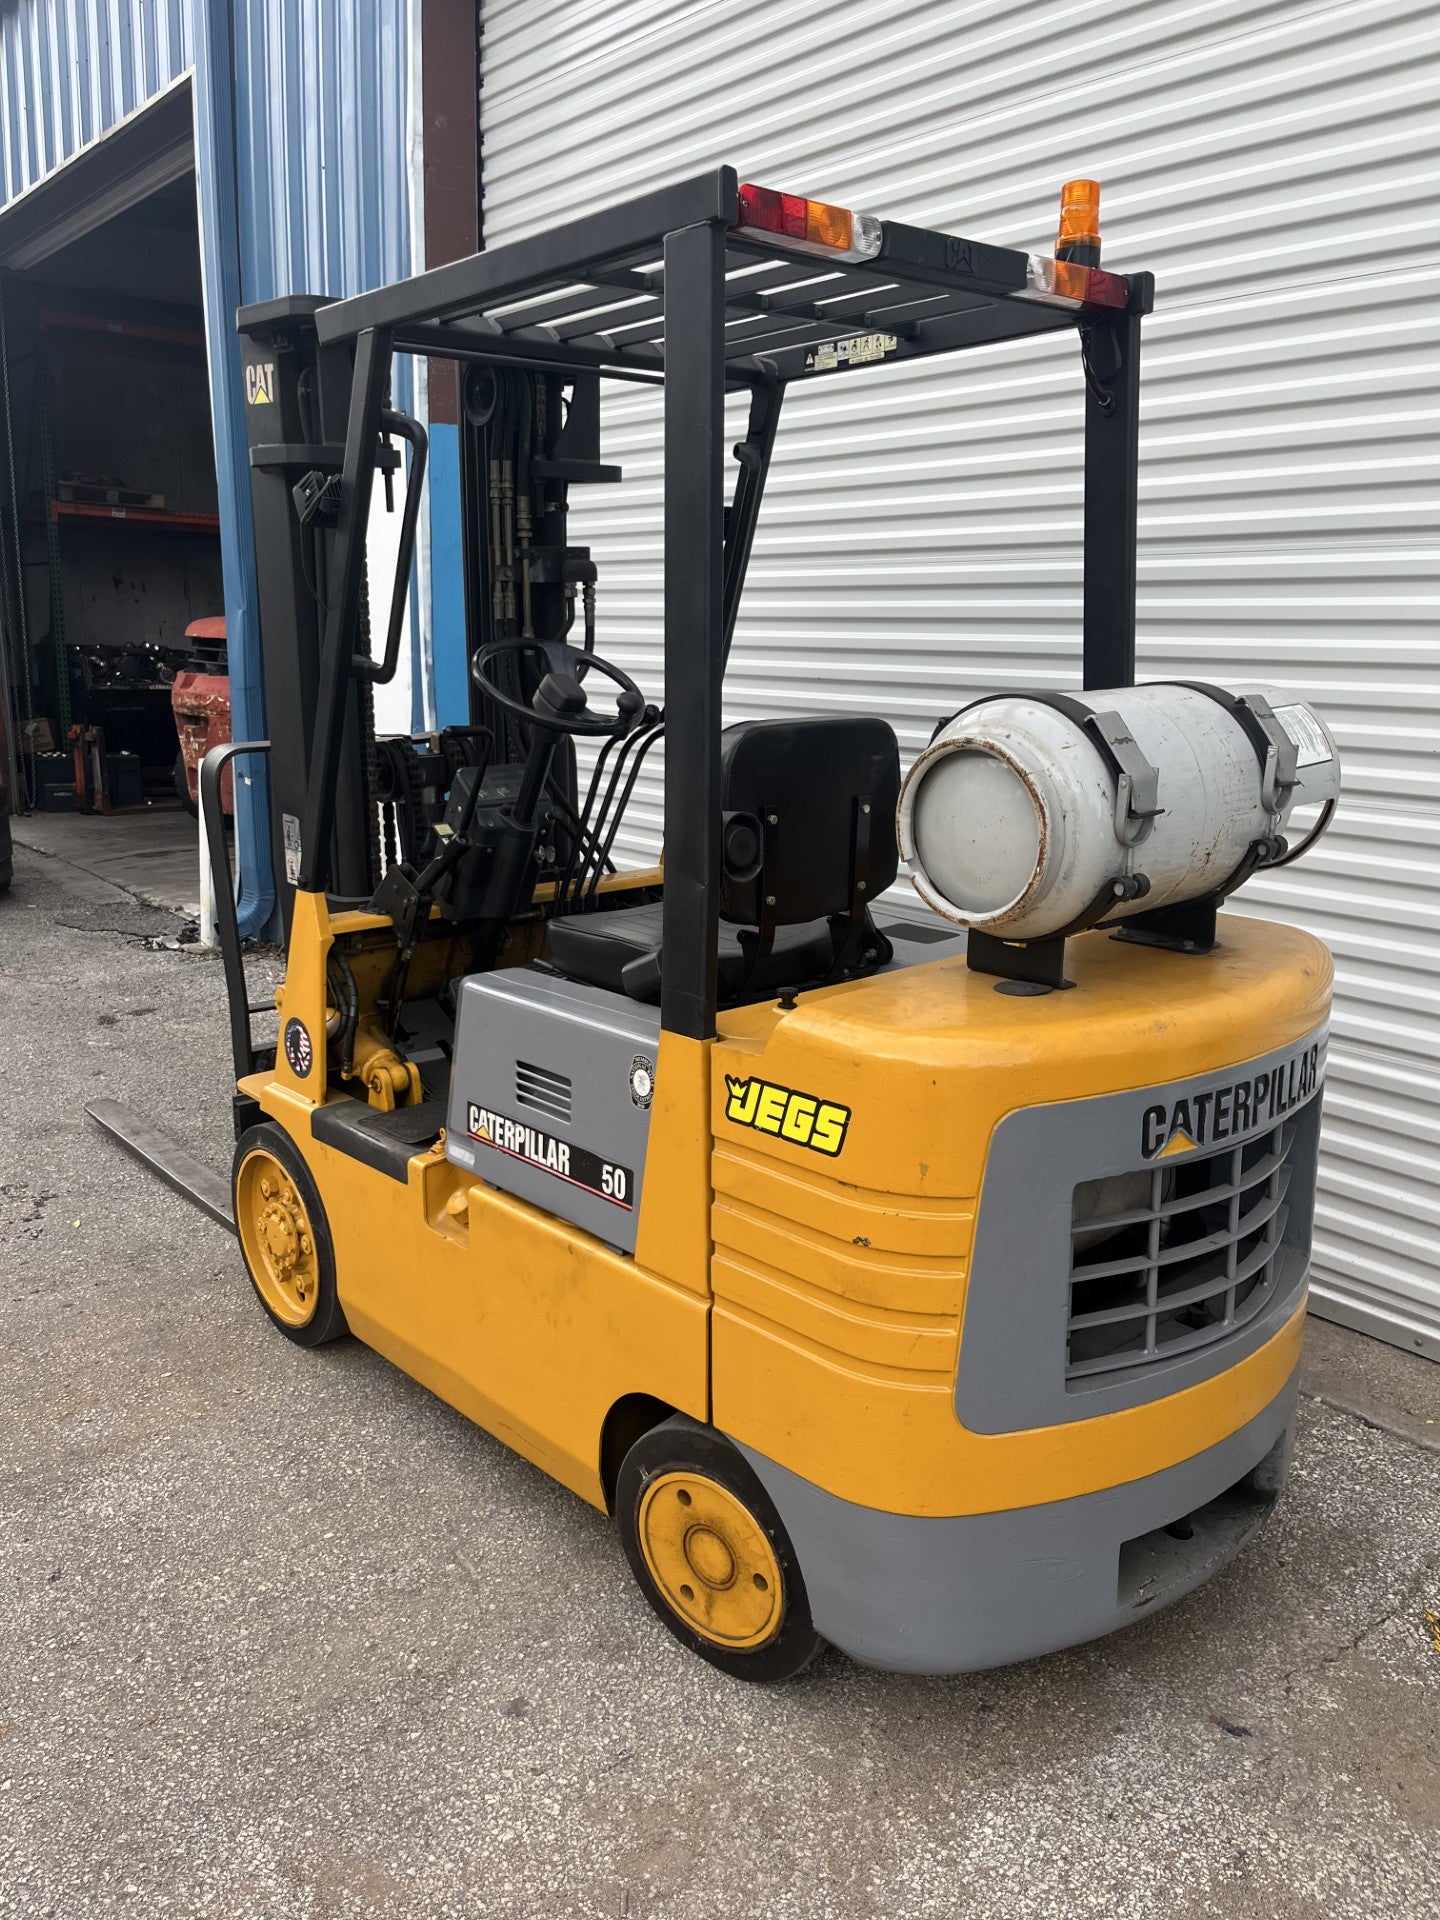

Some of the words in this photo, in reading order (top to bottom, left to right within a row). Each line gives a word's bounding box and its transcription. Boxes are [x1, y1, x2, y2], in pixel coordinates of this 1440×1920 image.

[945, 237, 979, 274] CAT
[246, 363, 274, 405] CAT
[727, 1080, 848, 1153] JEGS
[1141, 1043, 1318, 1160] CATERPILLAR
[469, 1105, 570, 1176] CATERPILLAR
[601, 1164, 627, 1200] 50
